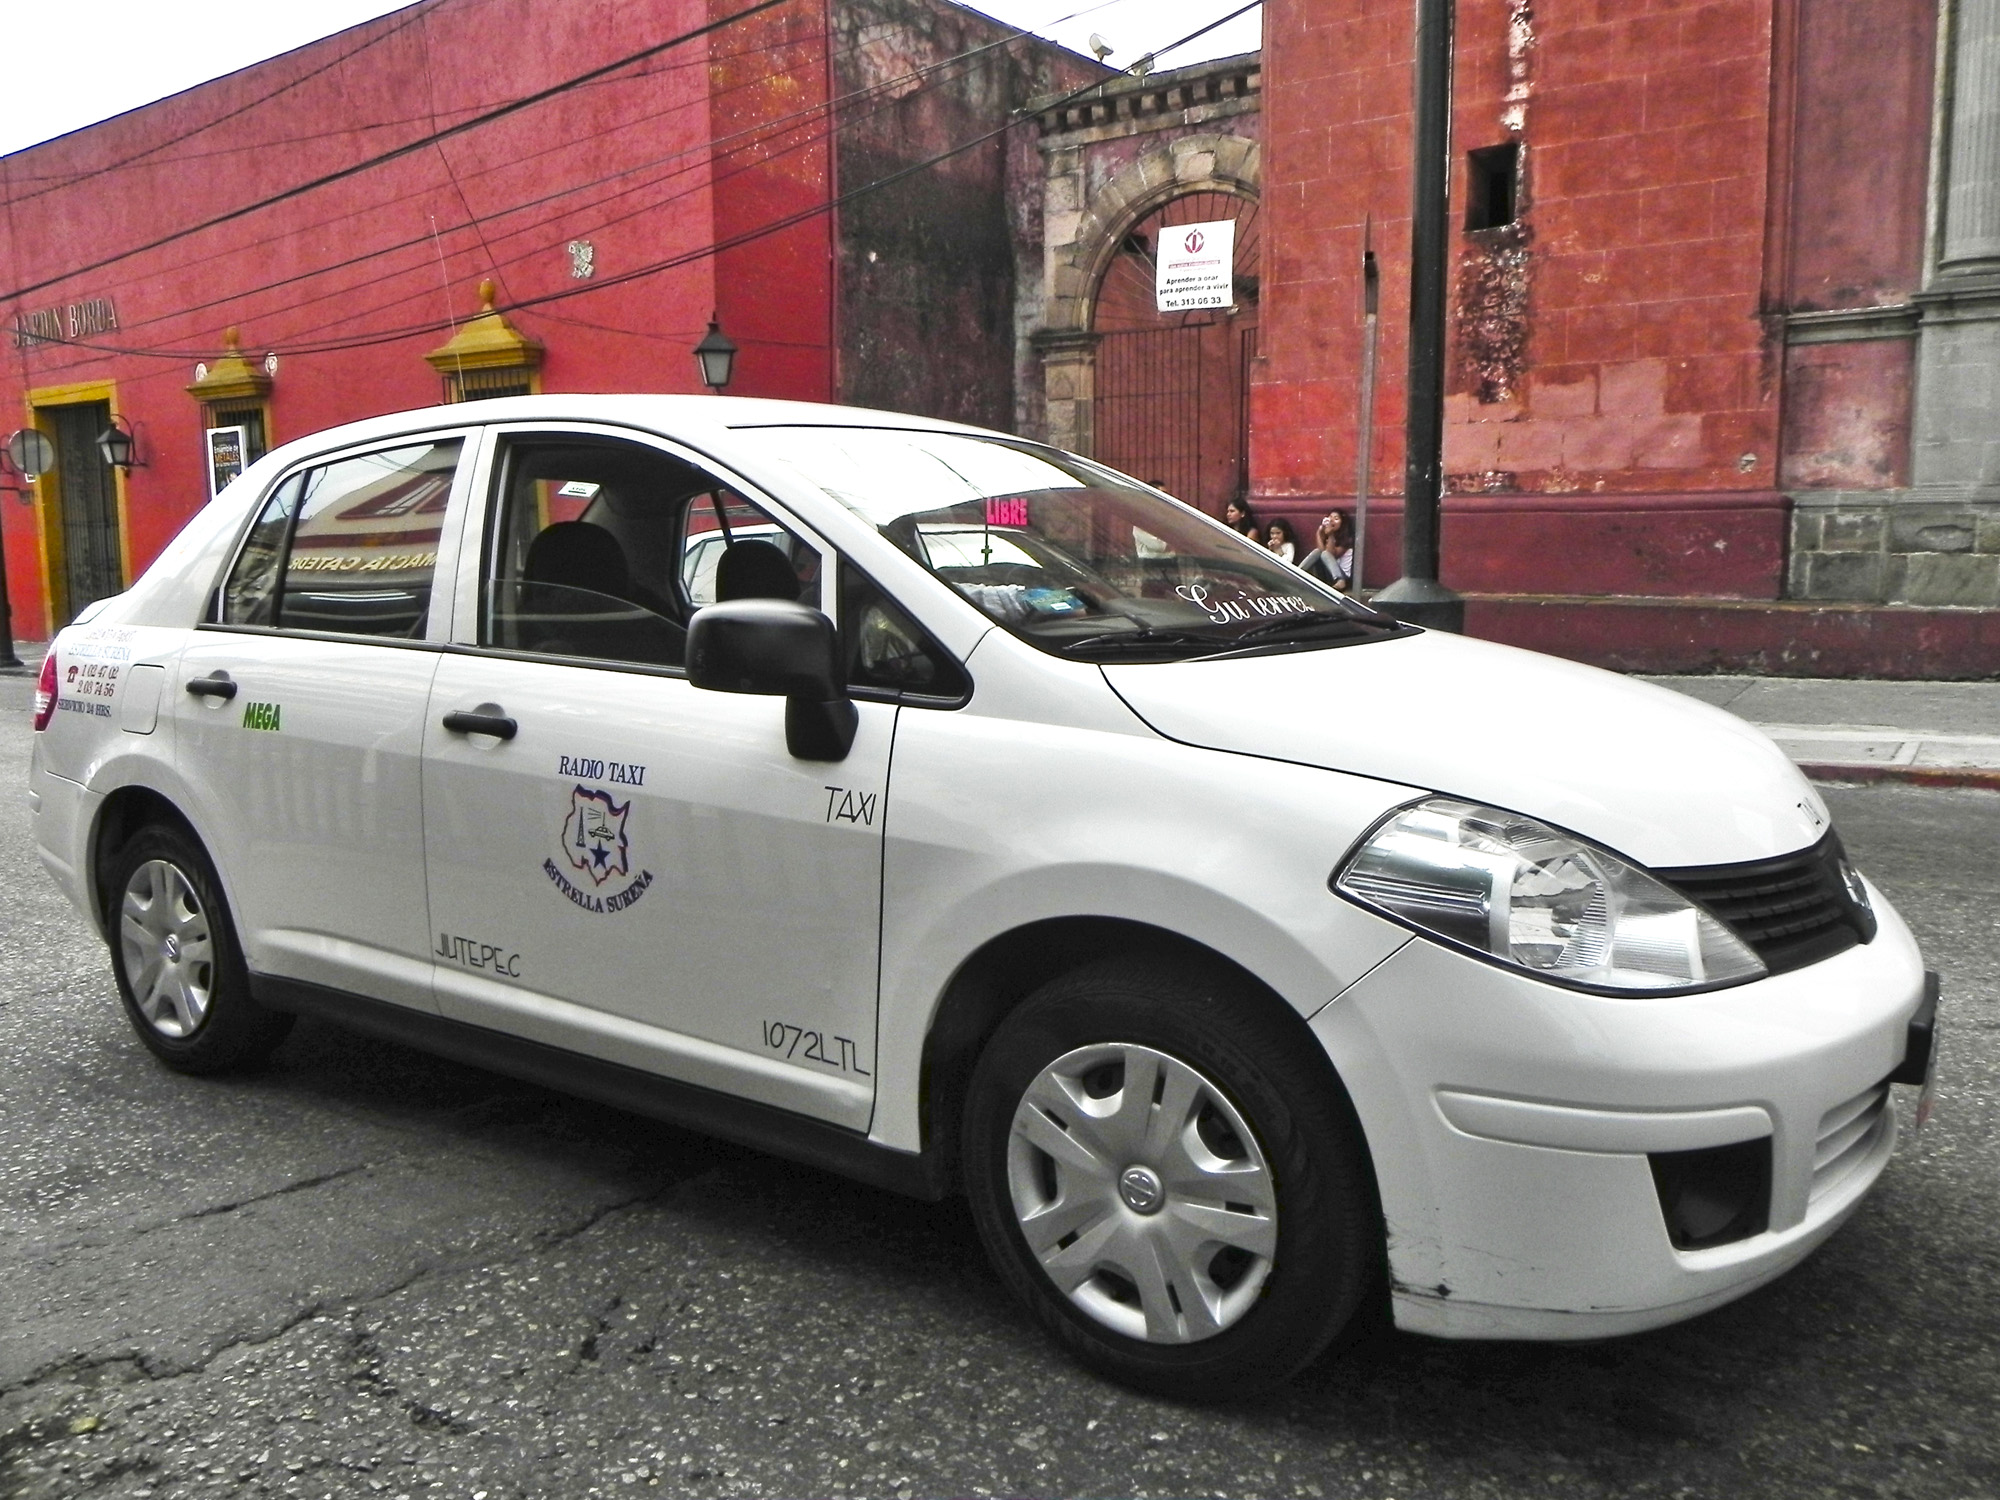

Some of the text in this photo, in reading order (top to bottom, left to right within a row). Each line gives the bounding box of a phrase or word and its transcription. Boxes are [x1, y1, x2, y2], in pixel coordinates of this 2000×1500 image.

[1160, 288, 1173, 296] para
[1175, 285, 1204, 293] aprender
[1166, 276, 1195, 286] Aprender
[1181, 298, 1195, 306] 313
[1211, 296, 1222, 304] 33
[69, 297, 119, 337] BORDA
[987, 496, 1028, 525] LIBRE
[57, 698, 85, 713] SERVICIO
[86, 702, 94, 714] 24
[243, 702, 280, 731] MEGA
[558, 755, 646, 786] RADIO TAXI
[824, 786, 876, 826] TAXI
[542, 857, 654, 914] ESTRELLA SUREÑA
[763, 1020, 871, 1076] 1072LTL
